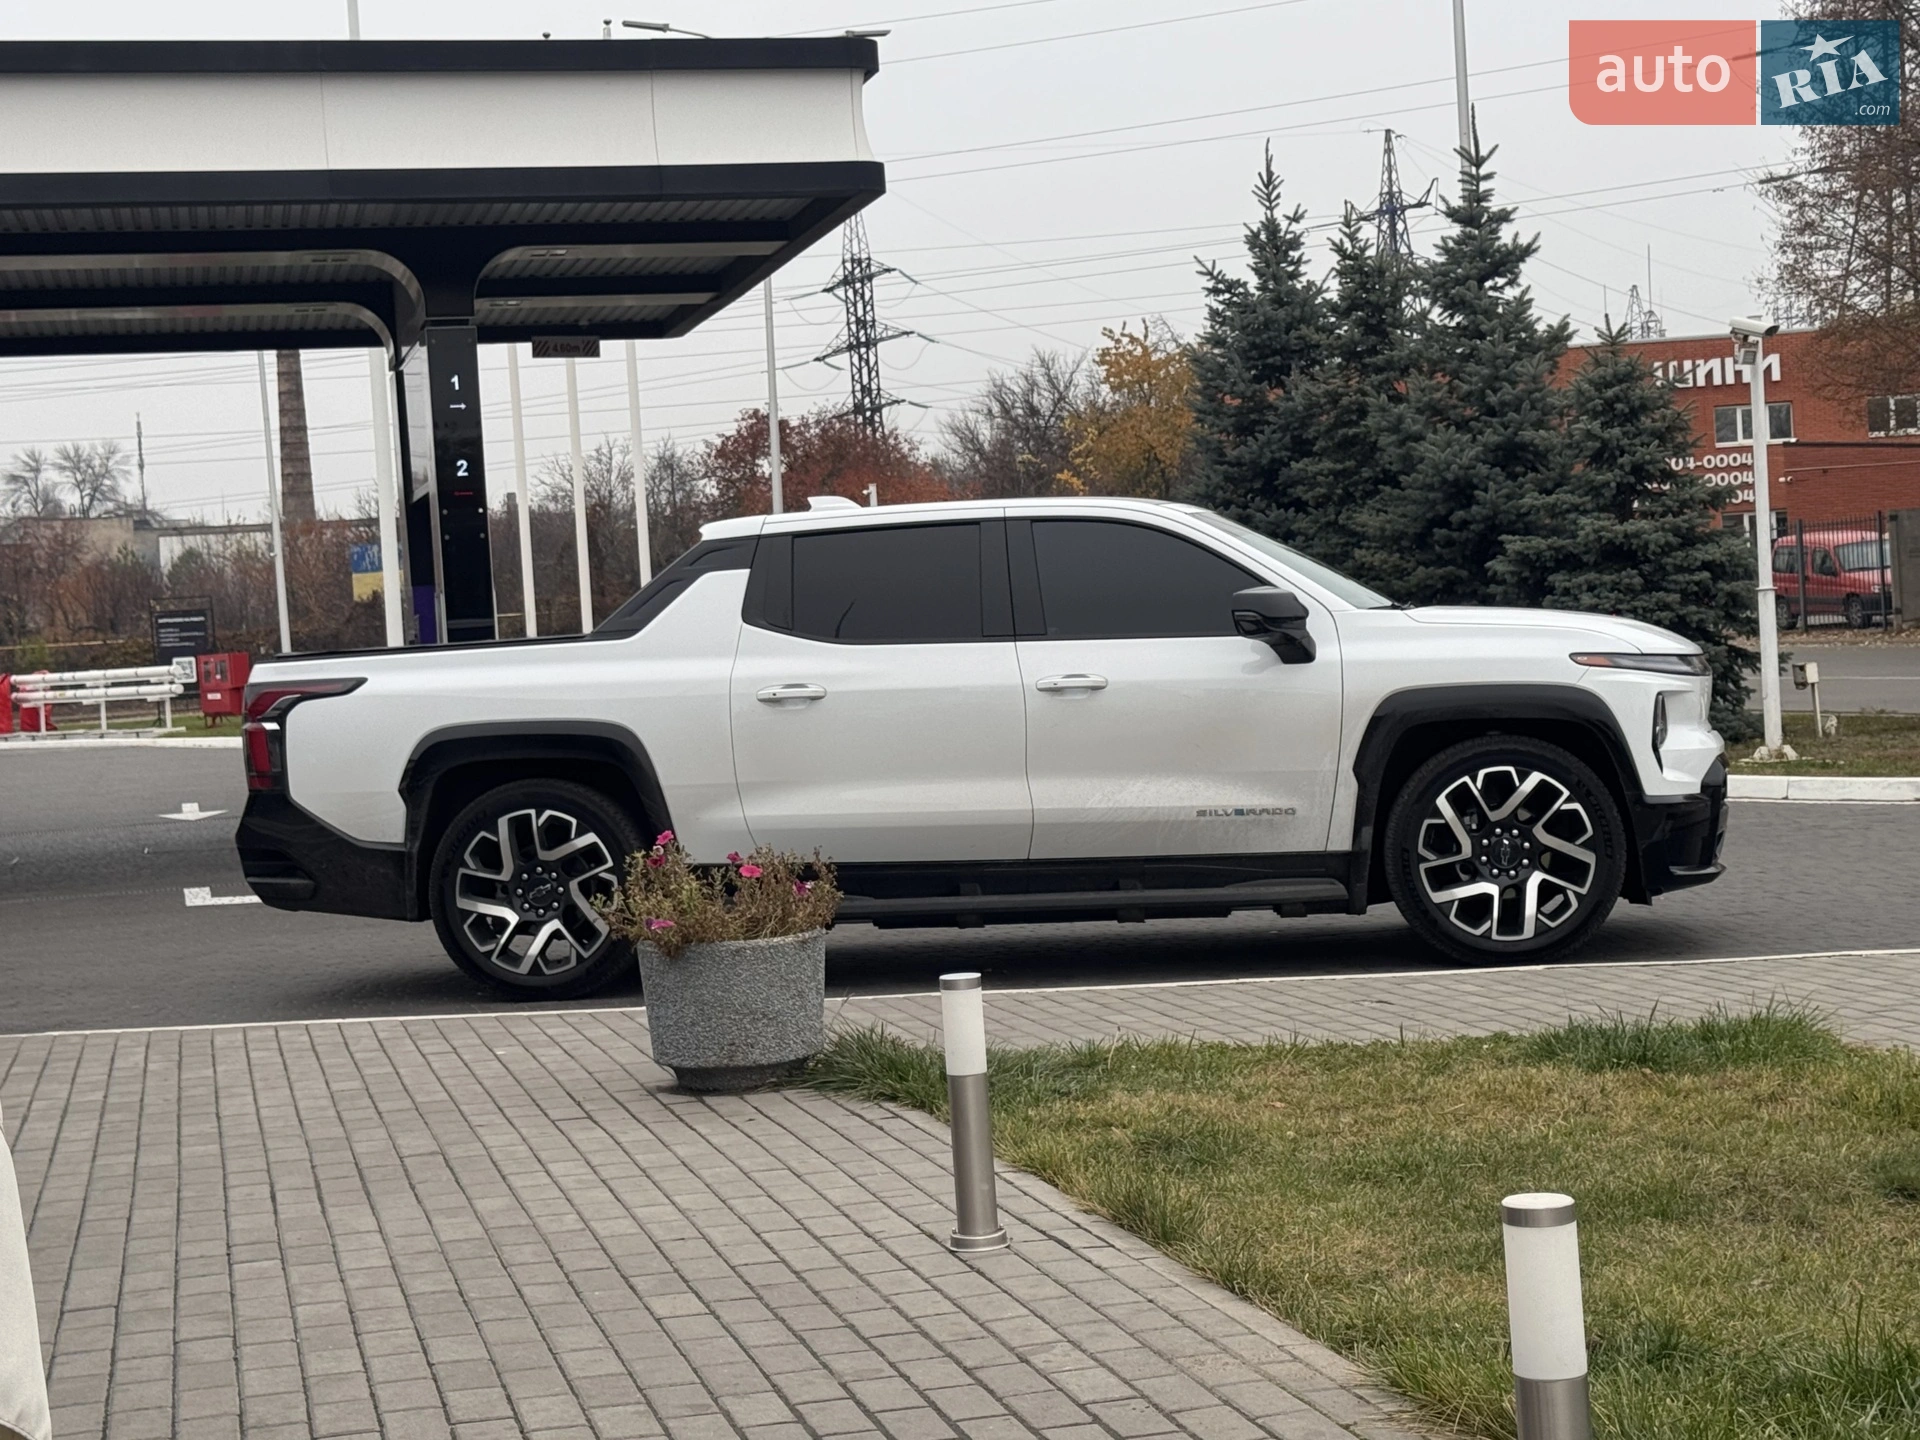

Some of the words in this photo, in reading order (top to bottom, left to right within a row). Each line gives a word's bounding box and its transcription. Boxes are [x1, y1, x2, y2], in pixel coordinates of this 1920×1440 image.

[450, 374, 460, 391] 1
[456, 459, 469, 477] 2
[1195, 807, 1297, 818] SILVERADO
